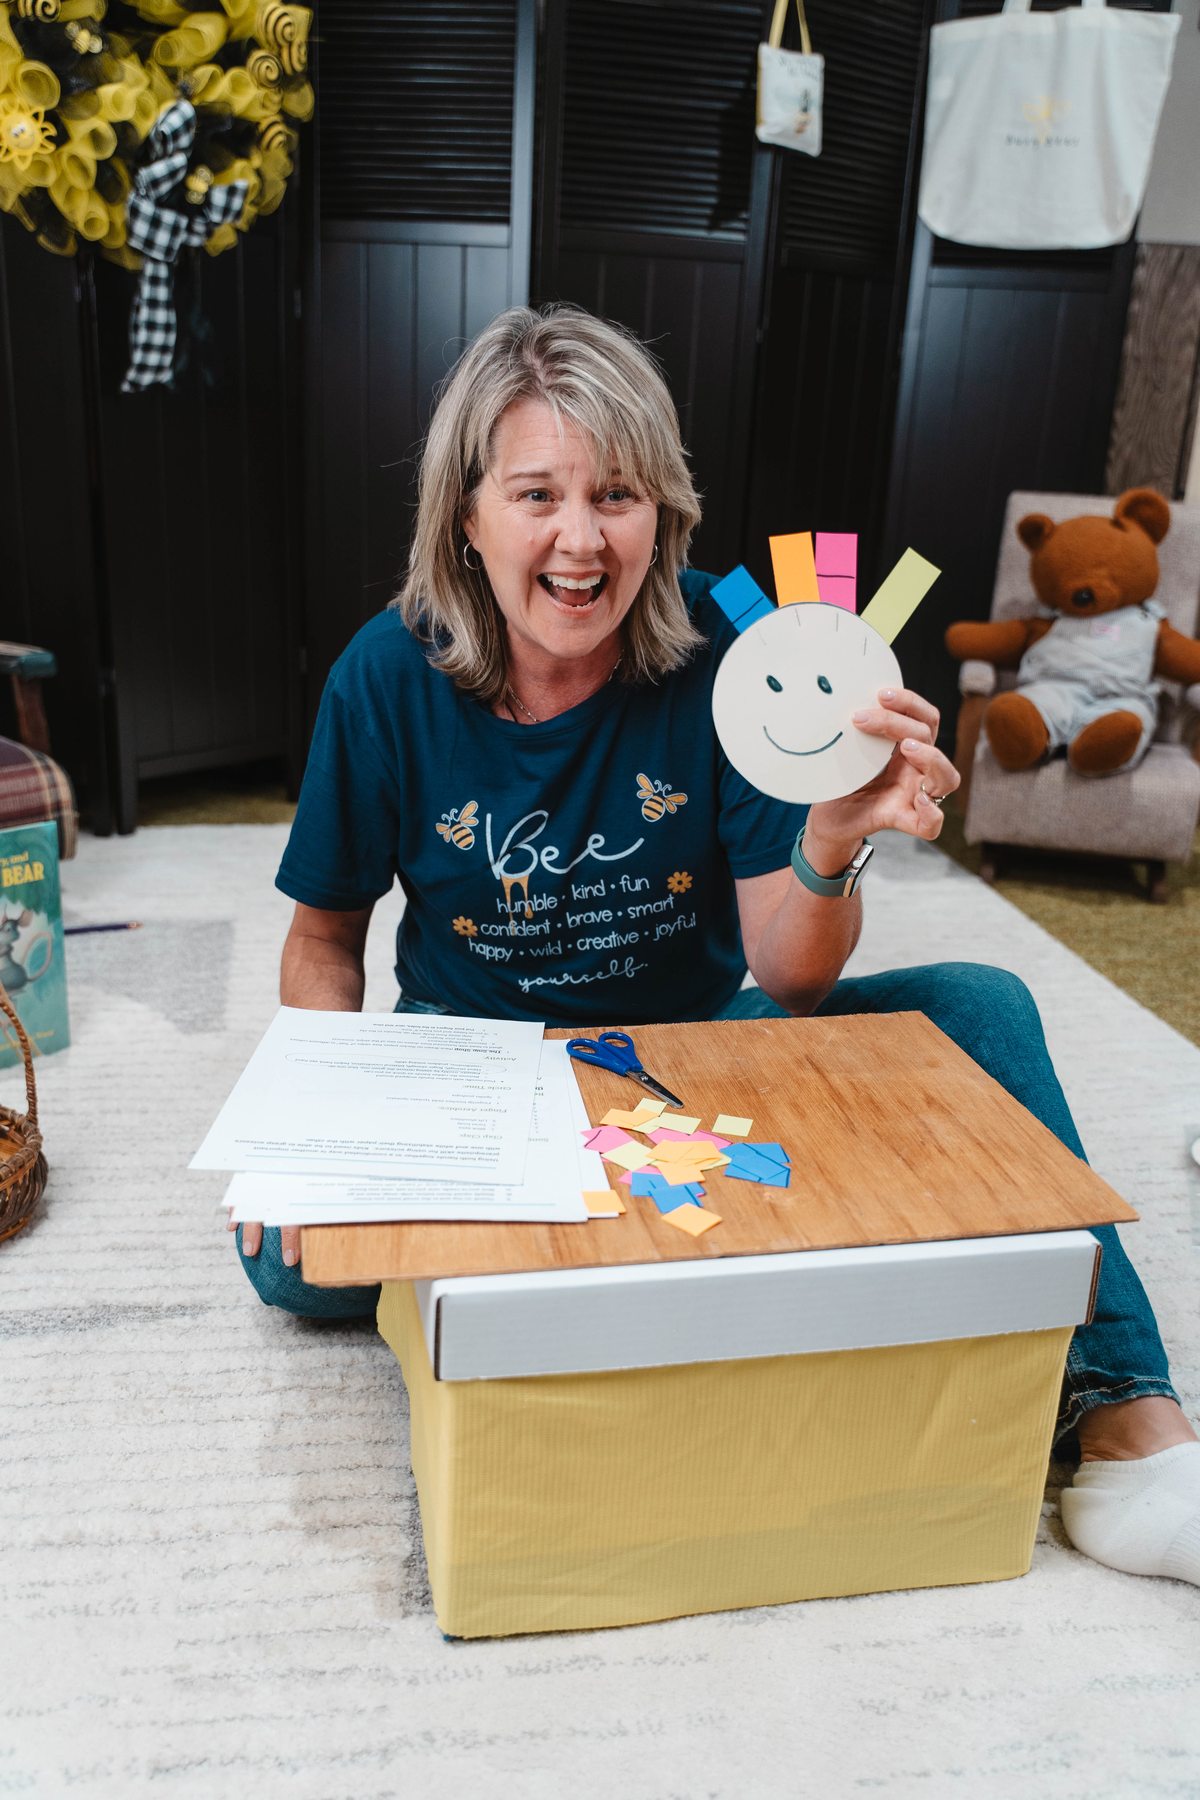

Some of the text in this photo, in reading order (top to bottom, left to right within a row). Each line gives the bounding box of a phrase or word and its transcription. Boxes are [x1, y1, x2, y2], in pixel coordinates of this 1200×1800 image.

[485, 809, 645, 881] Bee
[2, 861, 46, 888] BEAR
[496, 874, 651, 915] humble kind fun
[468, 912, 697, 962] happy wild creative joyful
[480, 893, 676, 938] confident brave smart
